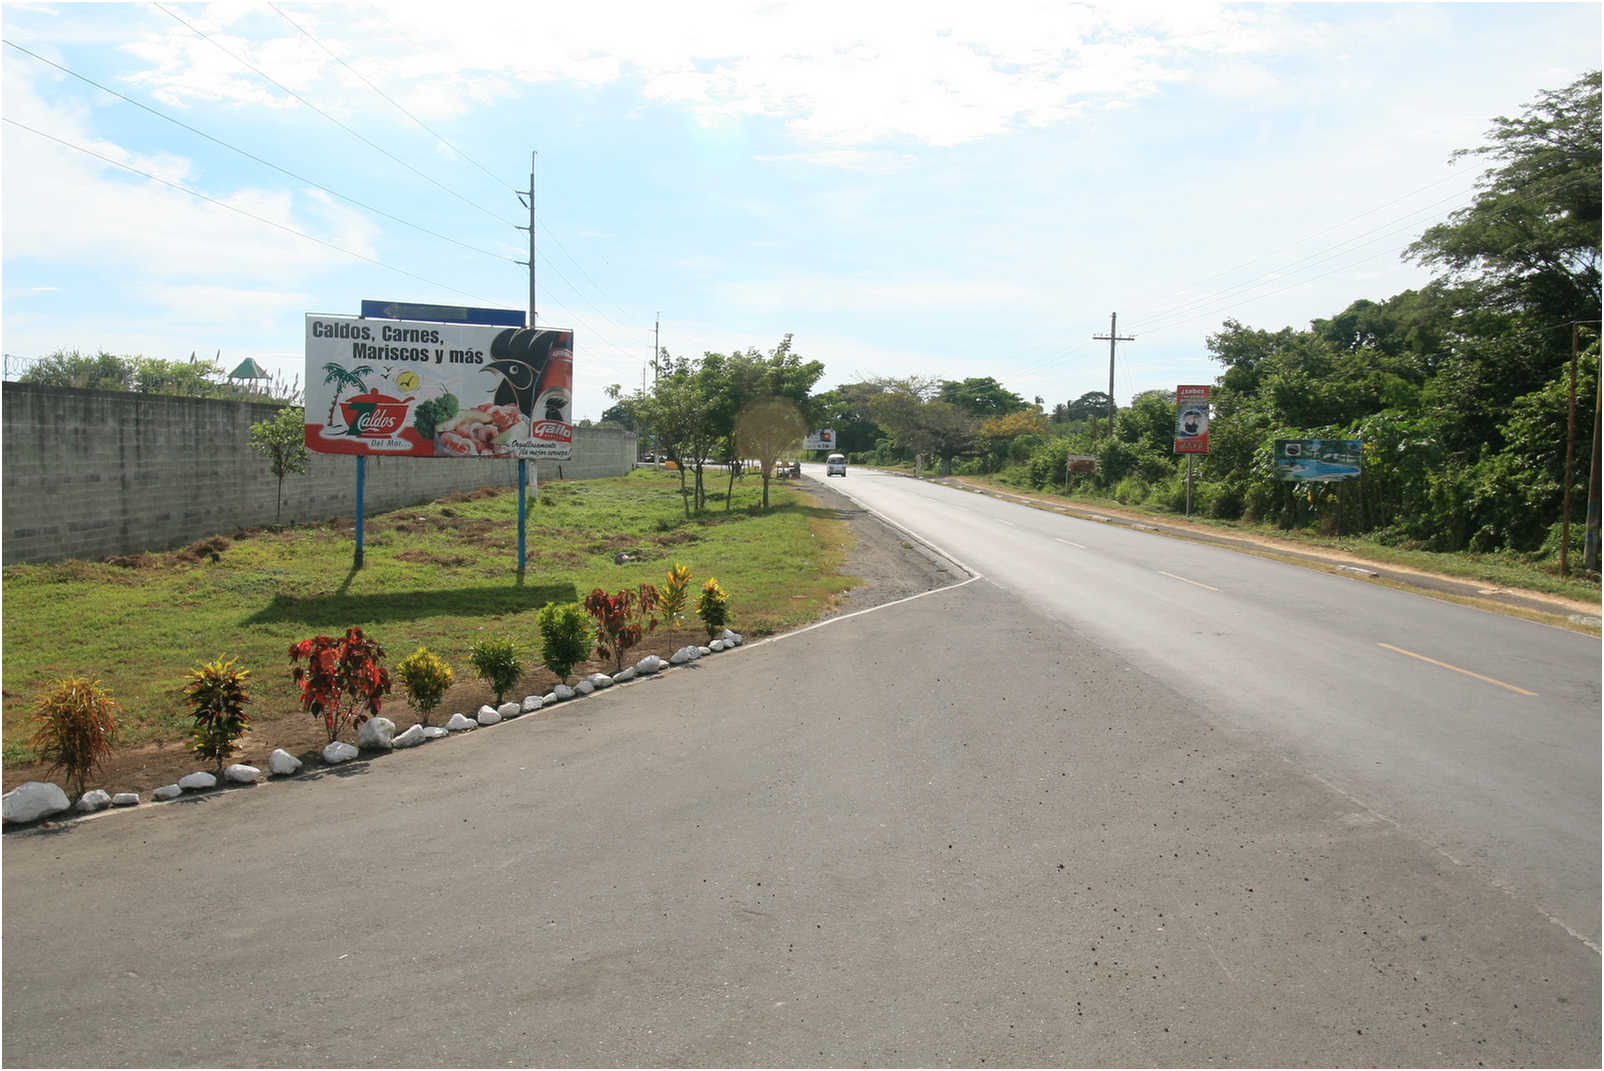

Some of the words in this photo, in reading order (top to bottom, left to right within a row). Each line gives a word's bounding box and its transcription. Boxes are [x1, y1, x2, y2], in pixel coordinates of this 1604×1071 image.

[312, 321, 376, 342] Caldos,
[382, 325, 444, 345] Carnes,
[353, 343, 430, 362] Mariscos
[435, 349, 444, 365] y
[449, 347, 484, 365] más
[357, 408, 397, 432] Caldos
[535, 422, 571, 437] Gallo
